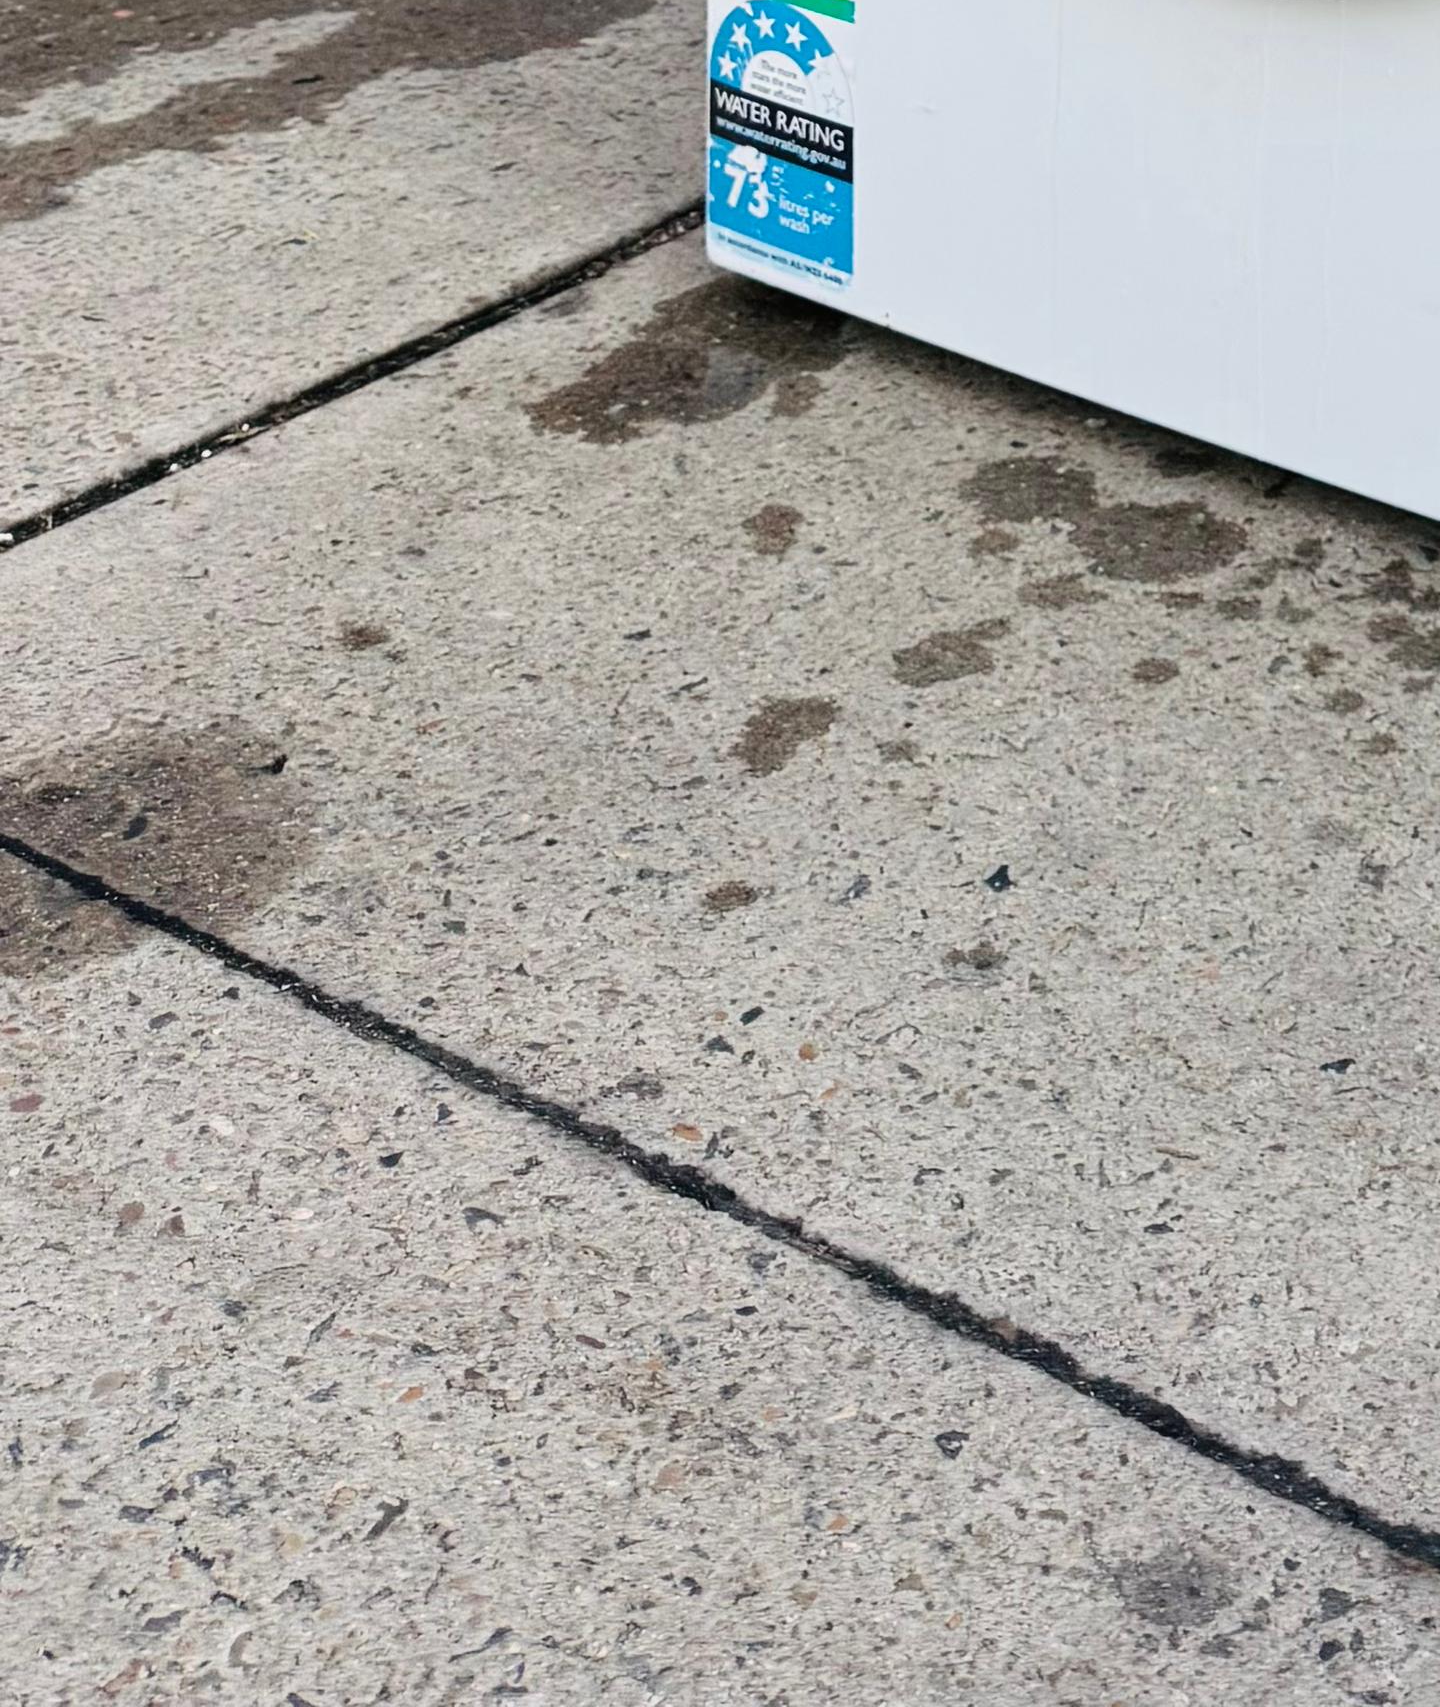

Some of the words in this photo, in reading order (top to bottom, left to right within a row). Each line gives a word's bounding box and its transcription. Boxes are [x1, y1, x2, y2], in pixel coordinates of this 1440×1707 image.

[714, 86, 772, 127] WATER
[776, 110, 845, 152] RATING
[716, 116, 847, 170] www.waterrating.gov.au
[779, 214, 811, 235] wash
[812, 210, 834, 226] per
